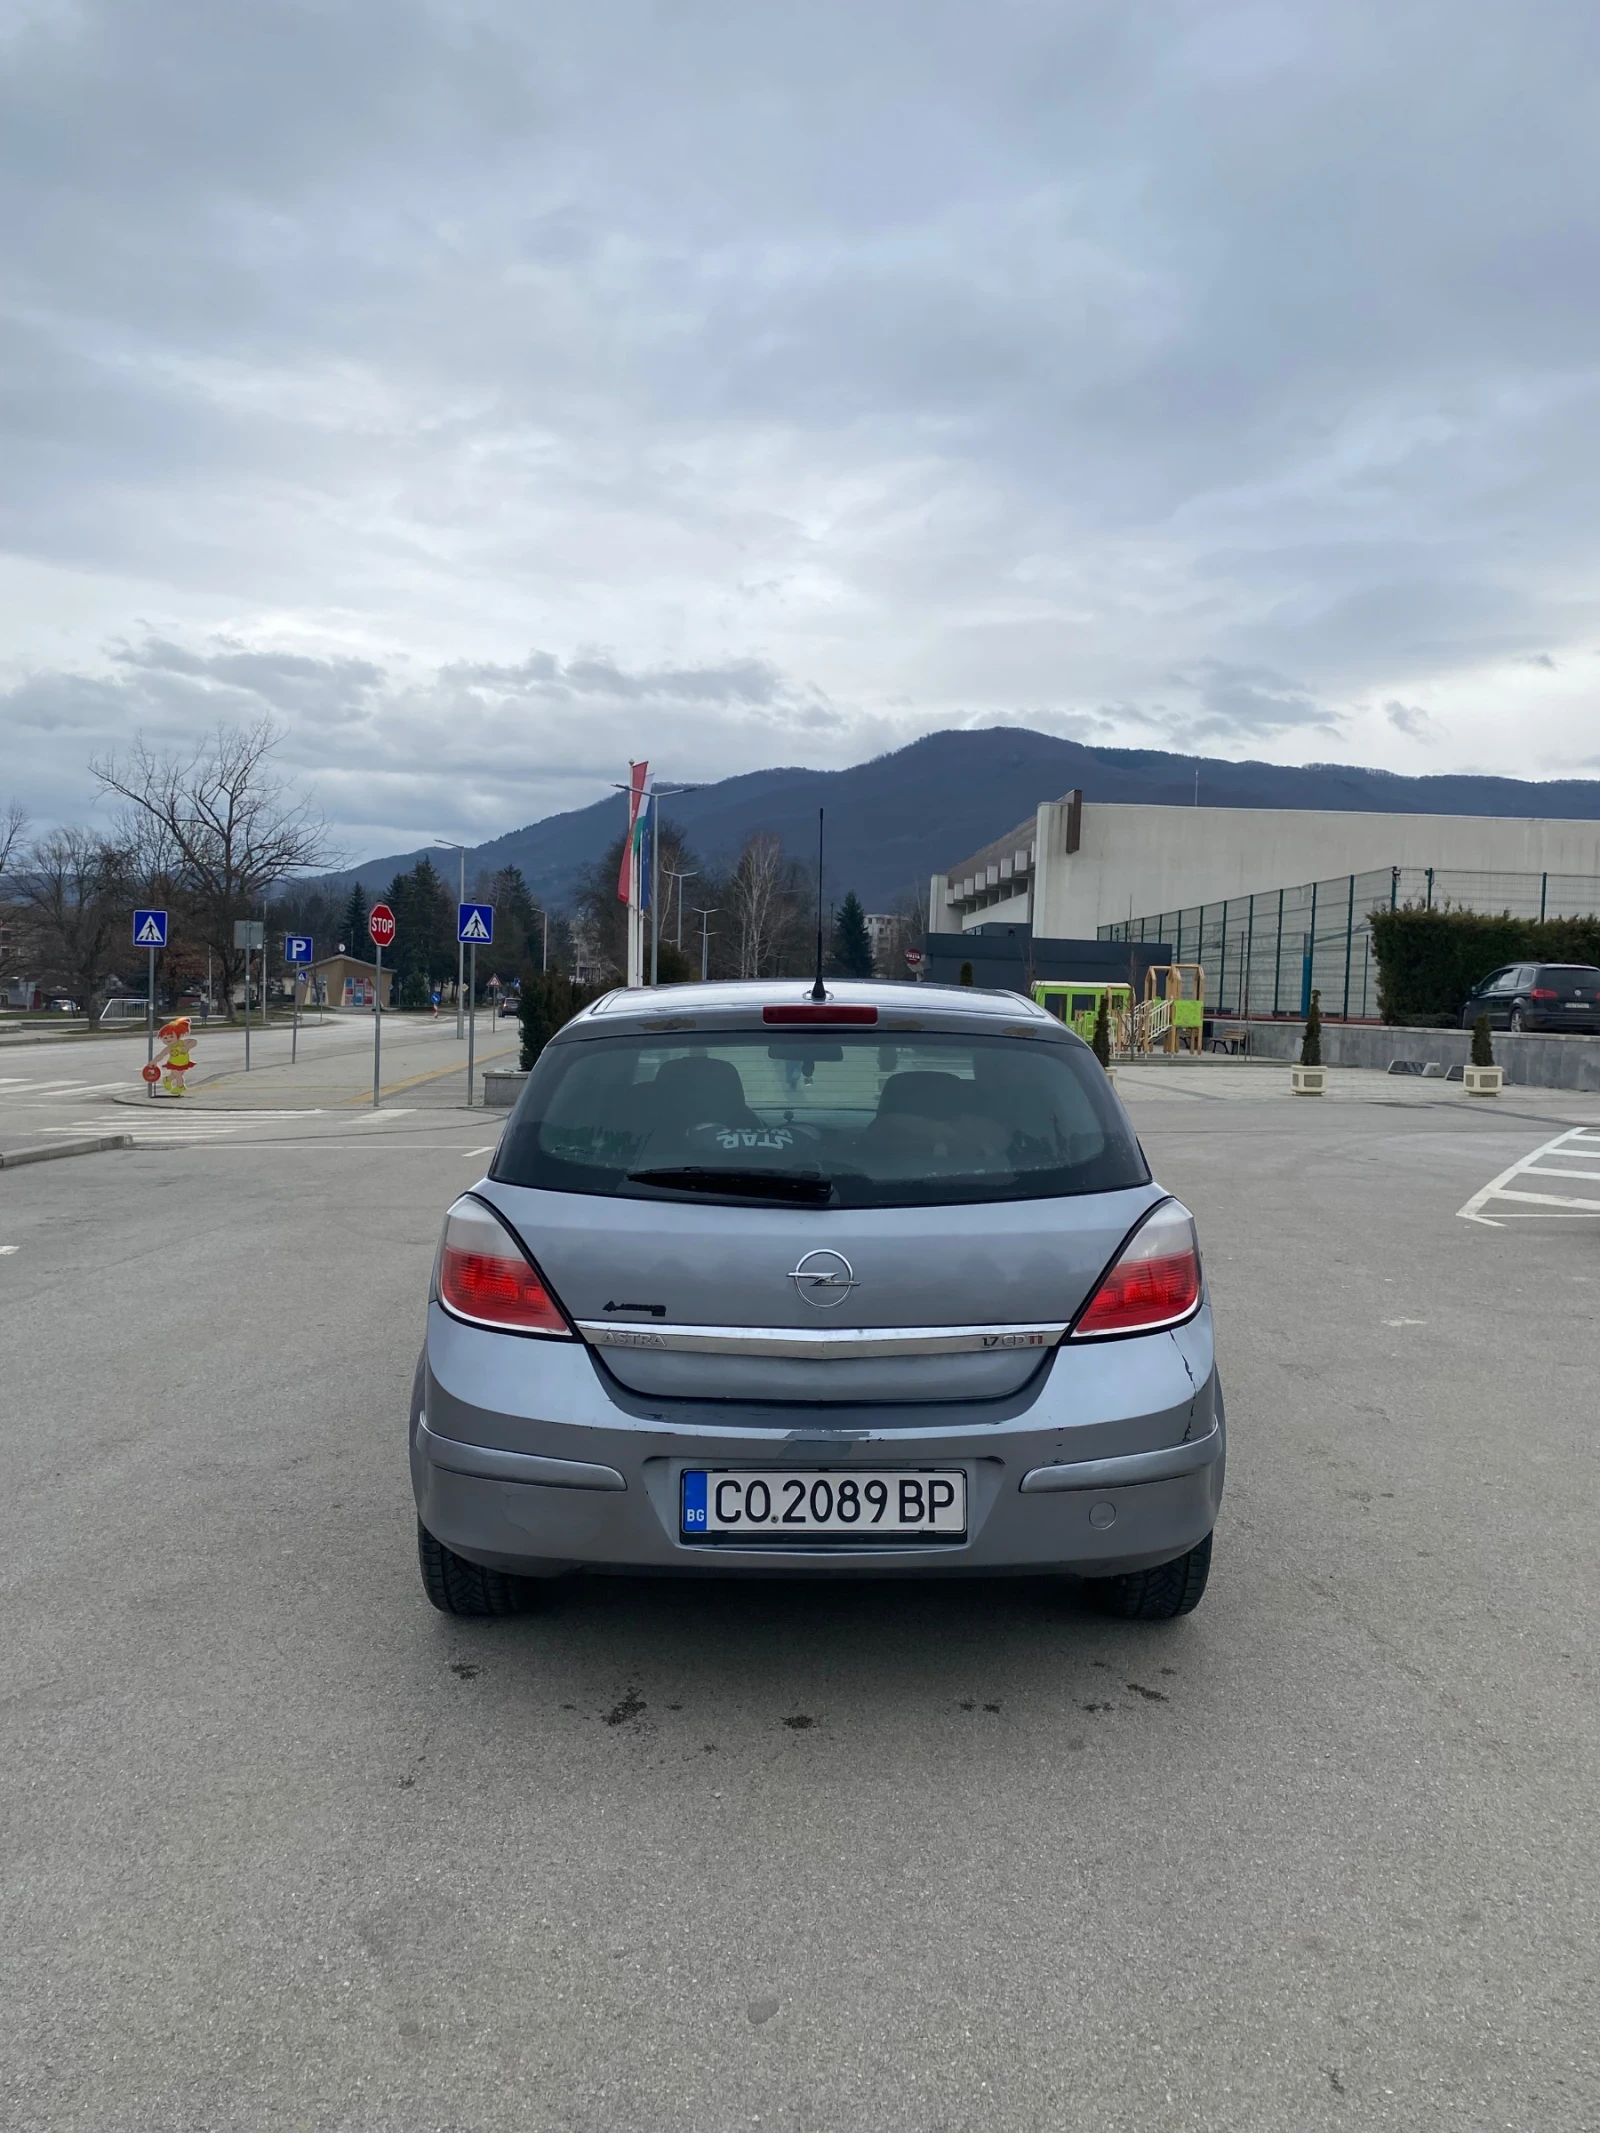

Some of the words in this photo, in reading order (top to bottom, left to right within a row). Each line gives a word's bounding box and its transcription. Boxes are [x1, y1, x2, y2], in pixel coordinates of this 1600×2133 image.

[371, 916, 393, 934] STOP
[292, 939, 306, 959] P
[602, 1332, 666, 1346] ASTRA
[687, 1509, 705, 1522] BG
